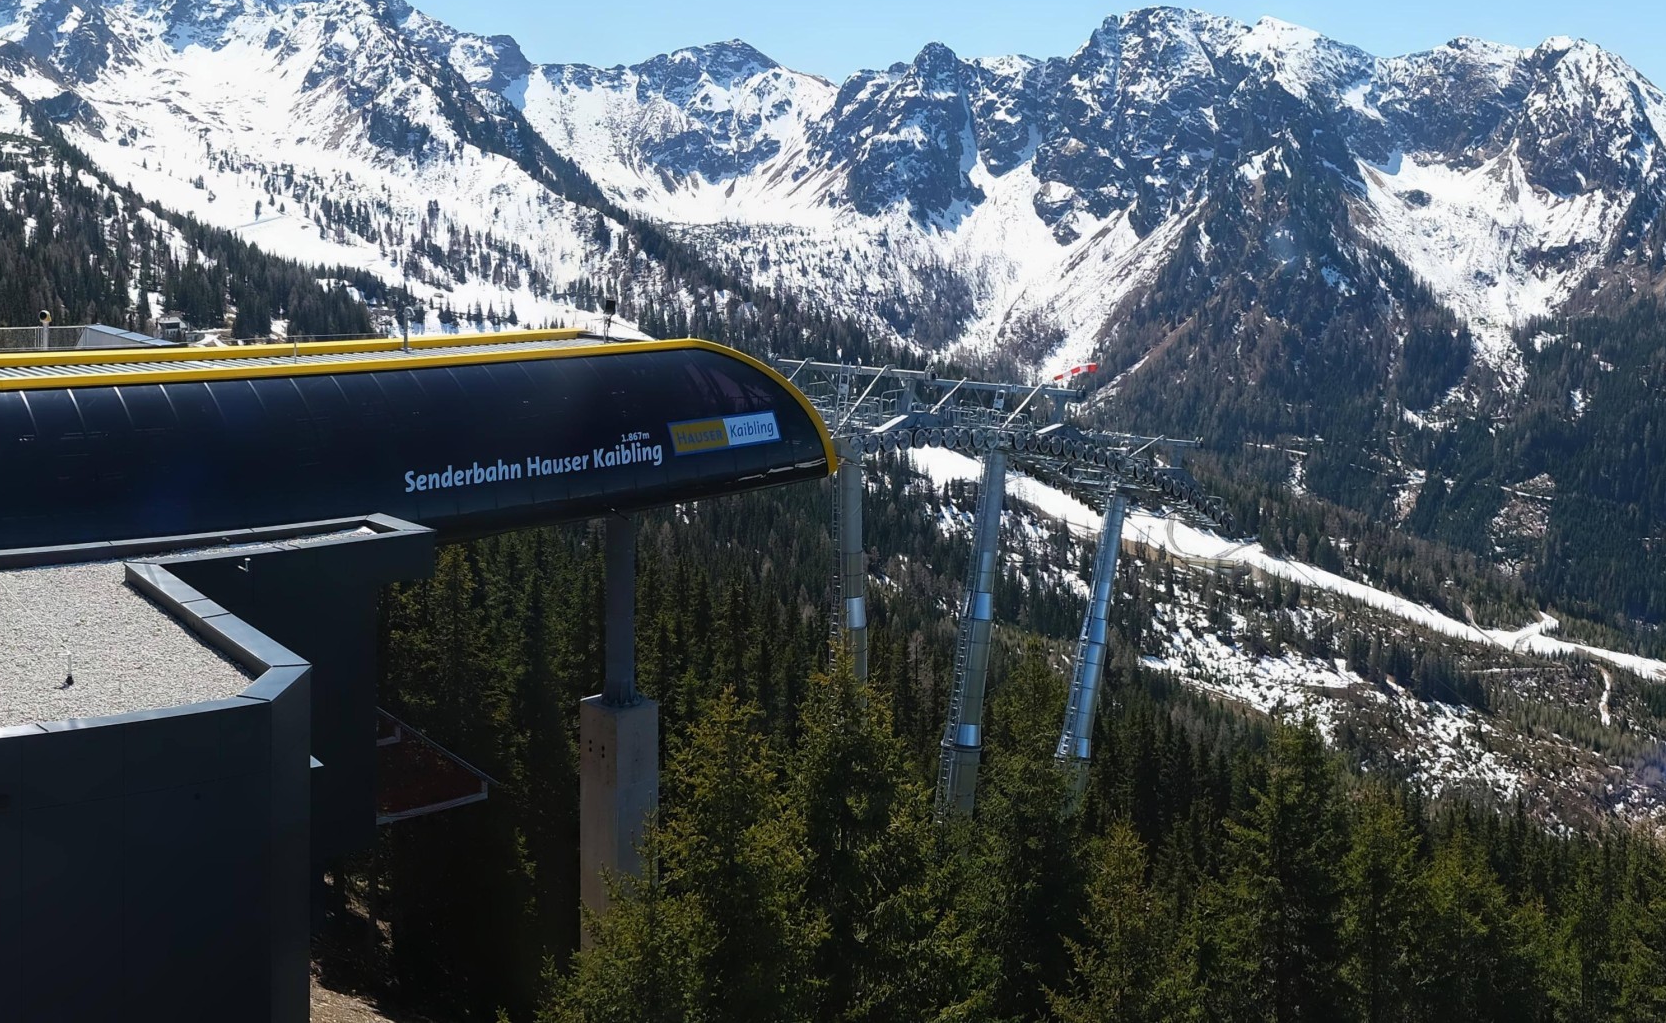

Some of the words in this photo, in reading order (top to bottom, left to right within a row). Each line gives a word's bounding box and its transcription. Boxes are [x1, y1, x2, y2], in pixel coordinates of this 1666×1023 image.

[677, 429, 724, 444] HAUSER
[729, 421, 774, 438] Kaibling
[404, 459, 522, 493] Senderbahn
[527, 455, 590, 477] Hauser
[593, 442, 663, 468] Kaibling
